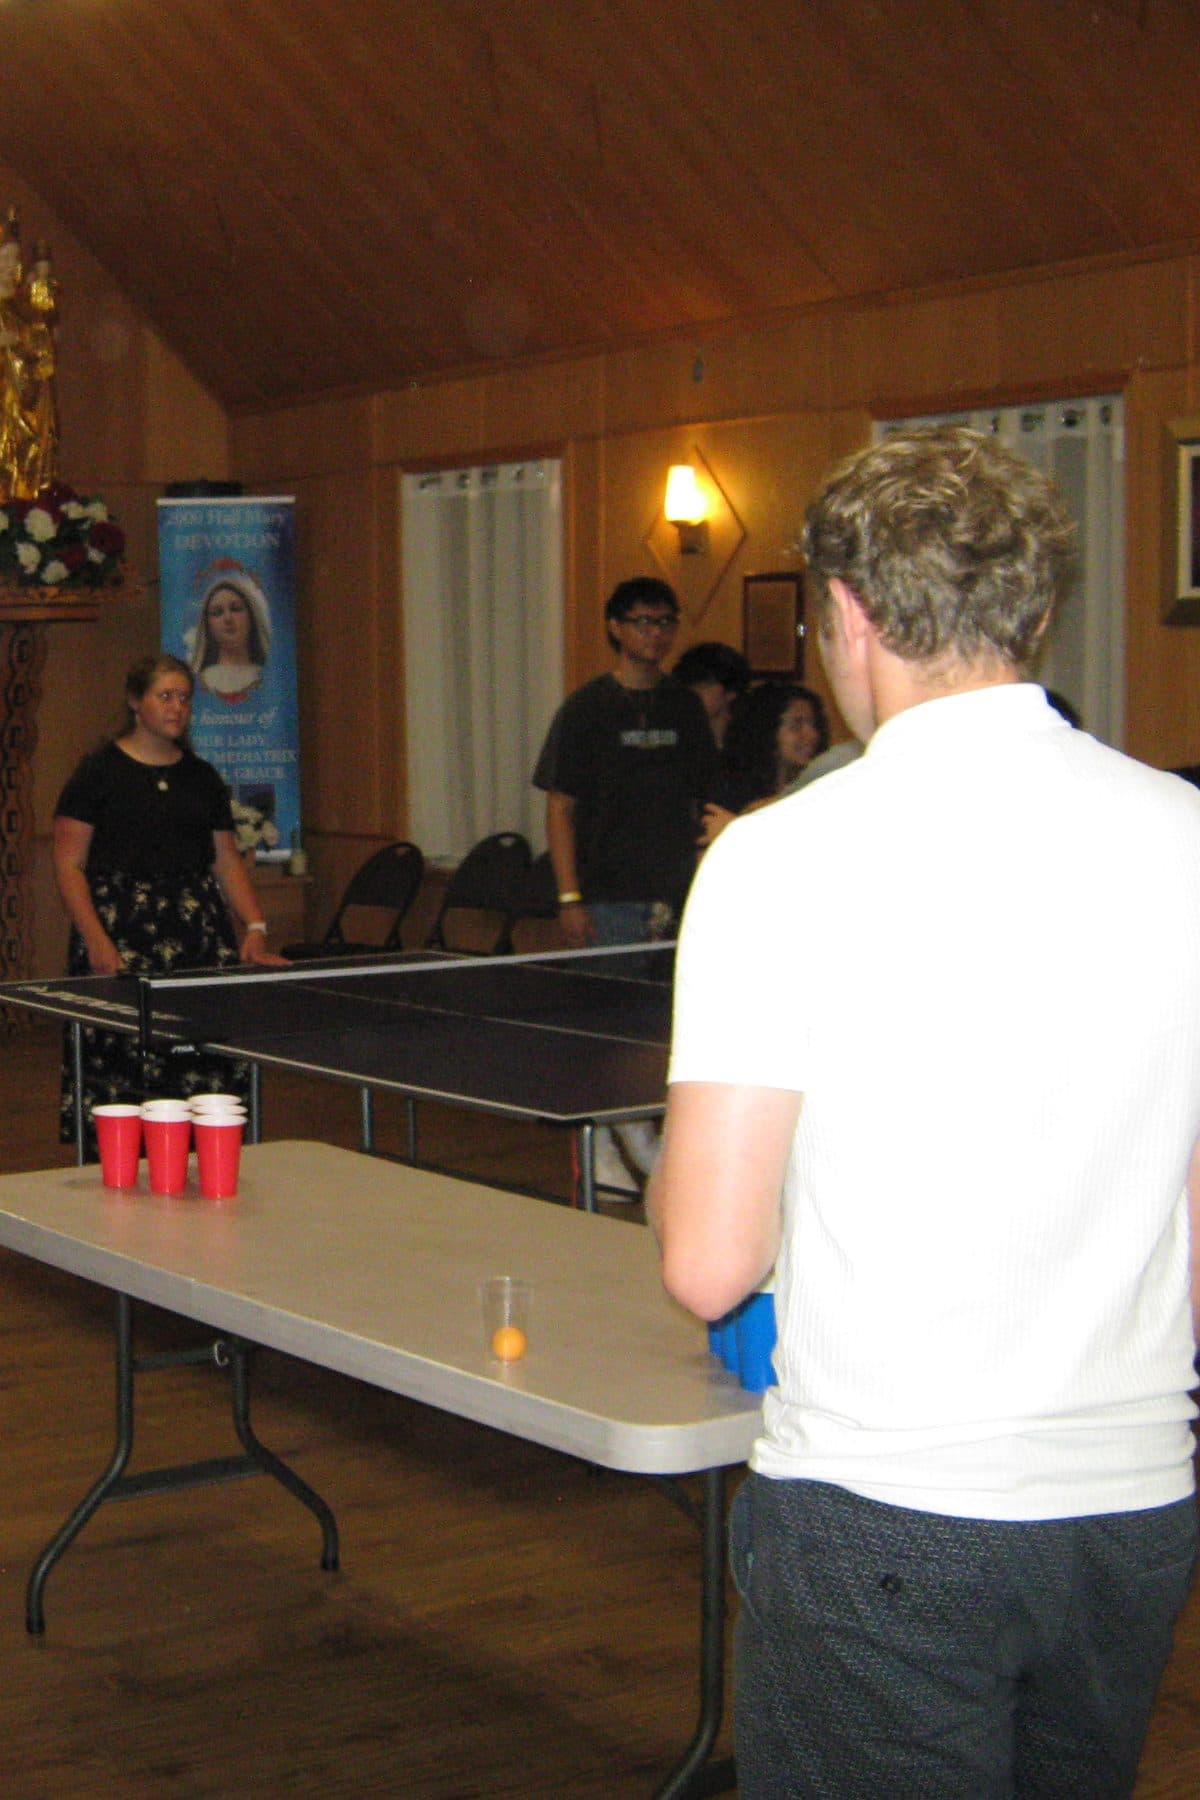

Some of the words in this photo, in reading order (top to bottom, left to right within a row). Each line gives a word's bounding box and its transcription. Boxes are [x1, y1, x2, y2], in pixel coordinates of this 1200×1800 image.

[174, 531, 280, 549] DEVOTION
[201, 708, 254, 725] honour
[228, 734, 266, 748] LADY
